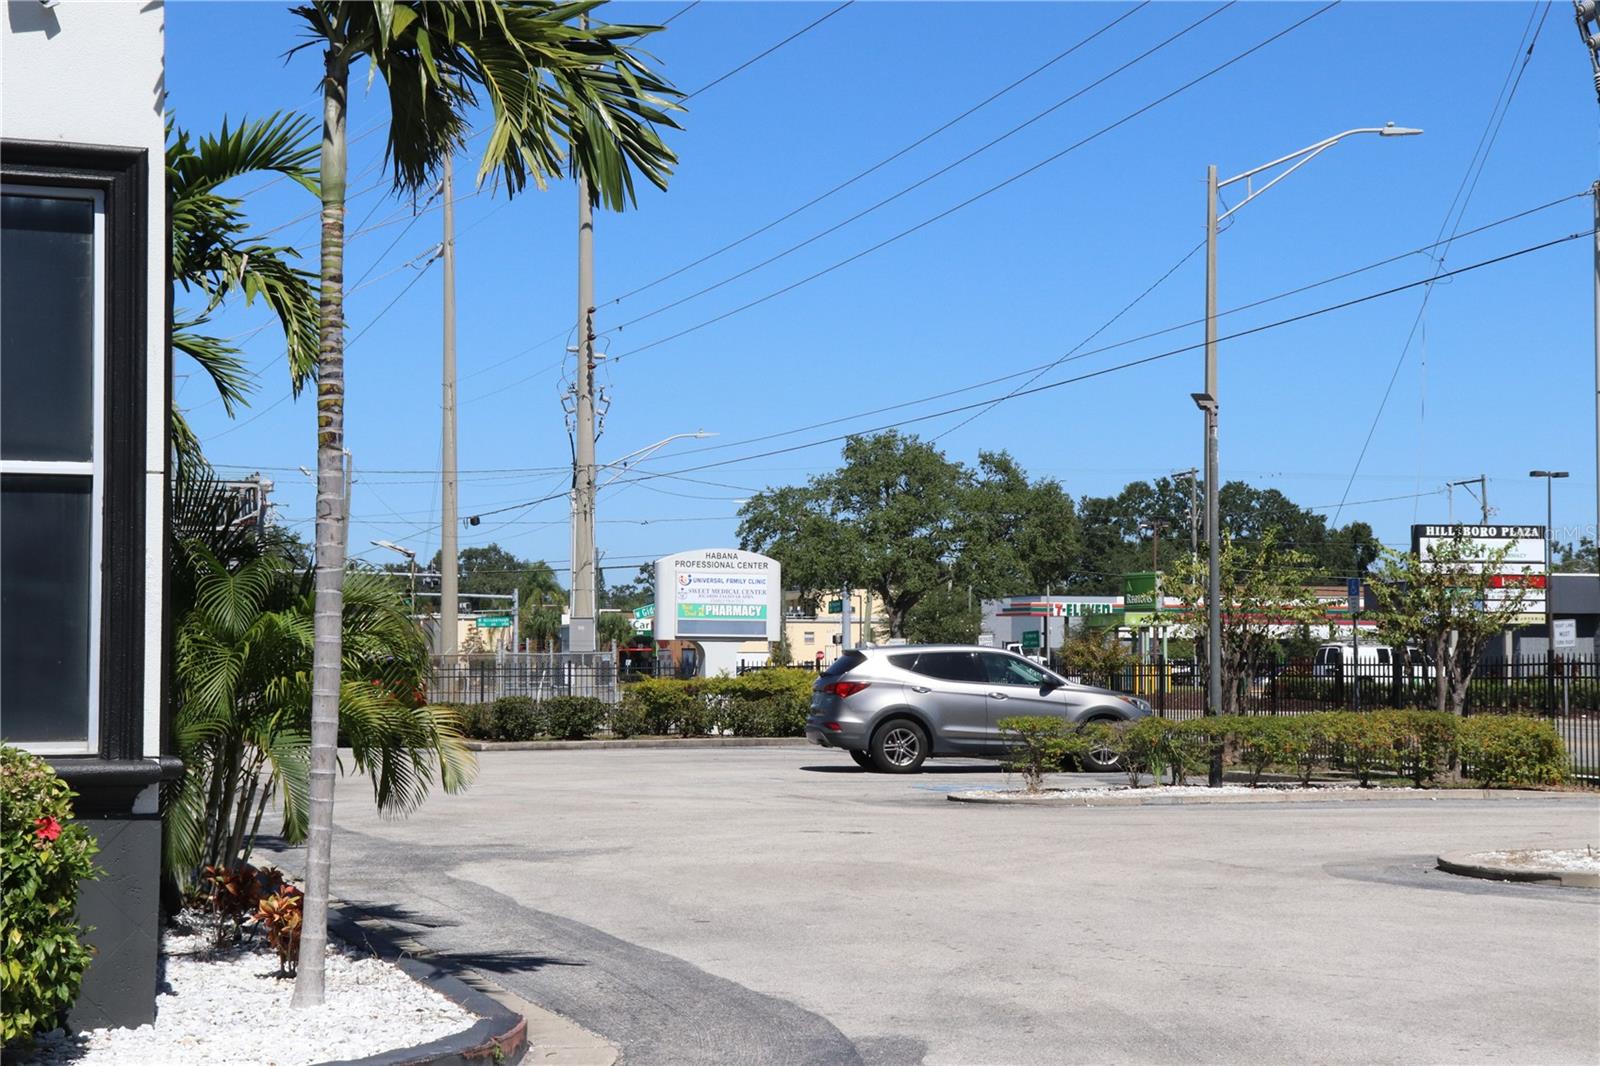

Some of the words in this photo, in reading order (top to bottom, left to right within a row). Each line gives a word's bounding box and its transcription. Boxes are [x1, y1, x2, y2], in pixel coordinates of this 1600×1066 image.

[1426, 526, 1497, 537] HILLBORO
[1501, 527, 1539, 537] PLAZA
[705, 552, 738, 560] HABANA
[675, 560, 735, 569] PROFESSIONAL
[737, 561, 769, 570] CENTER
[705, 605, 762, 617] PHARMACY
[633, 620, 650, 629] Car
